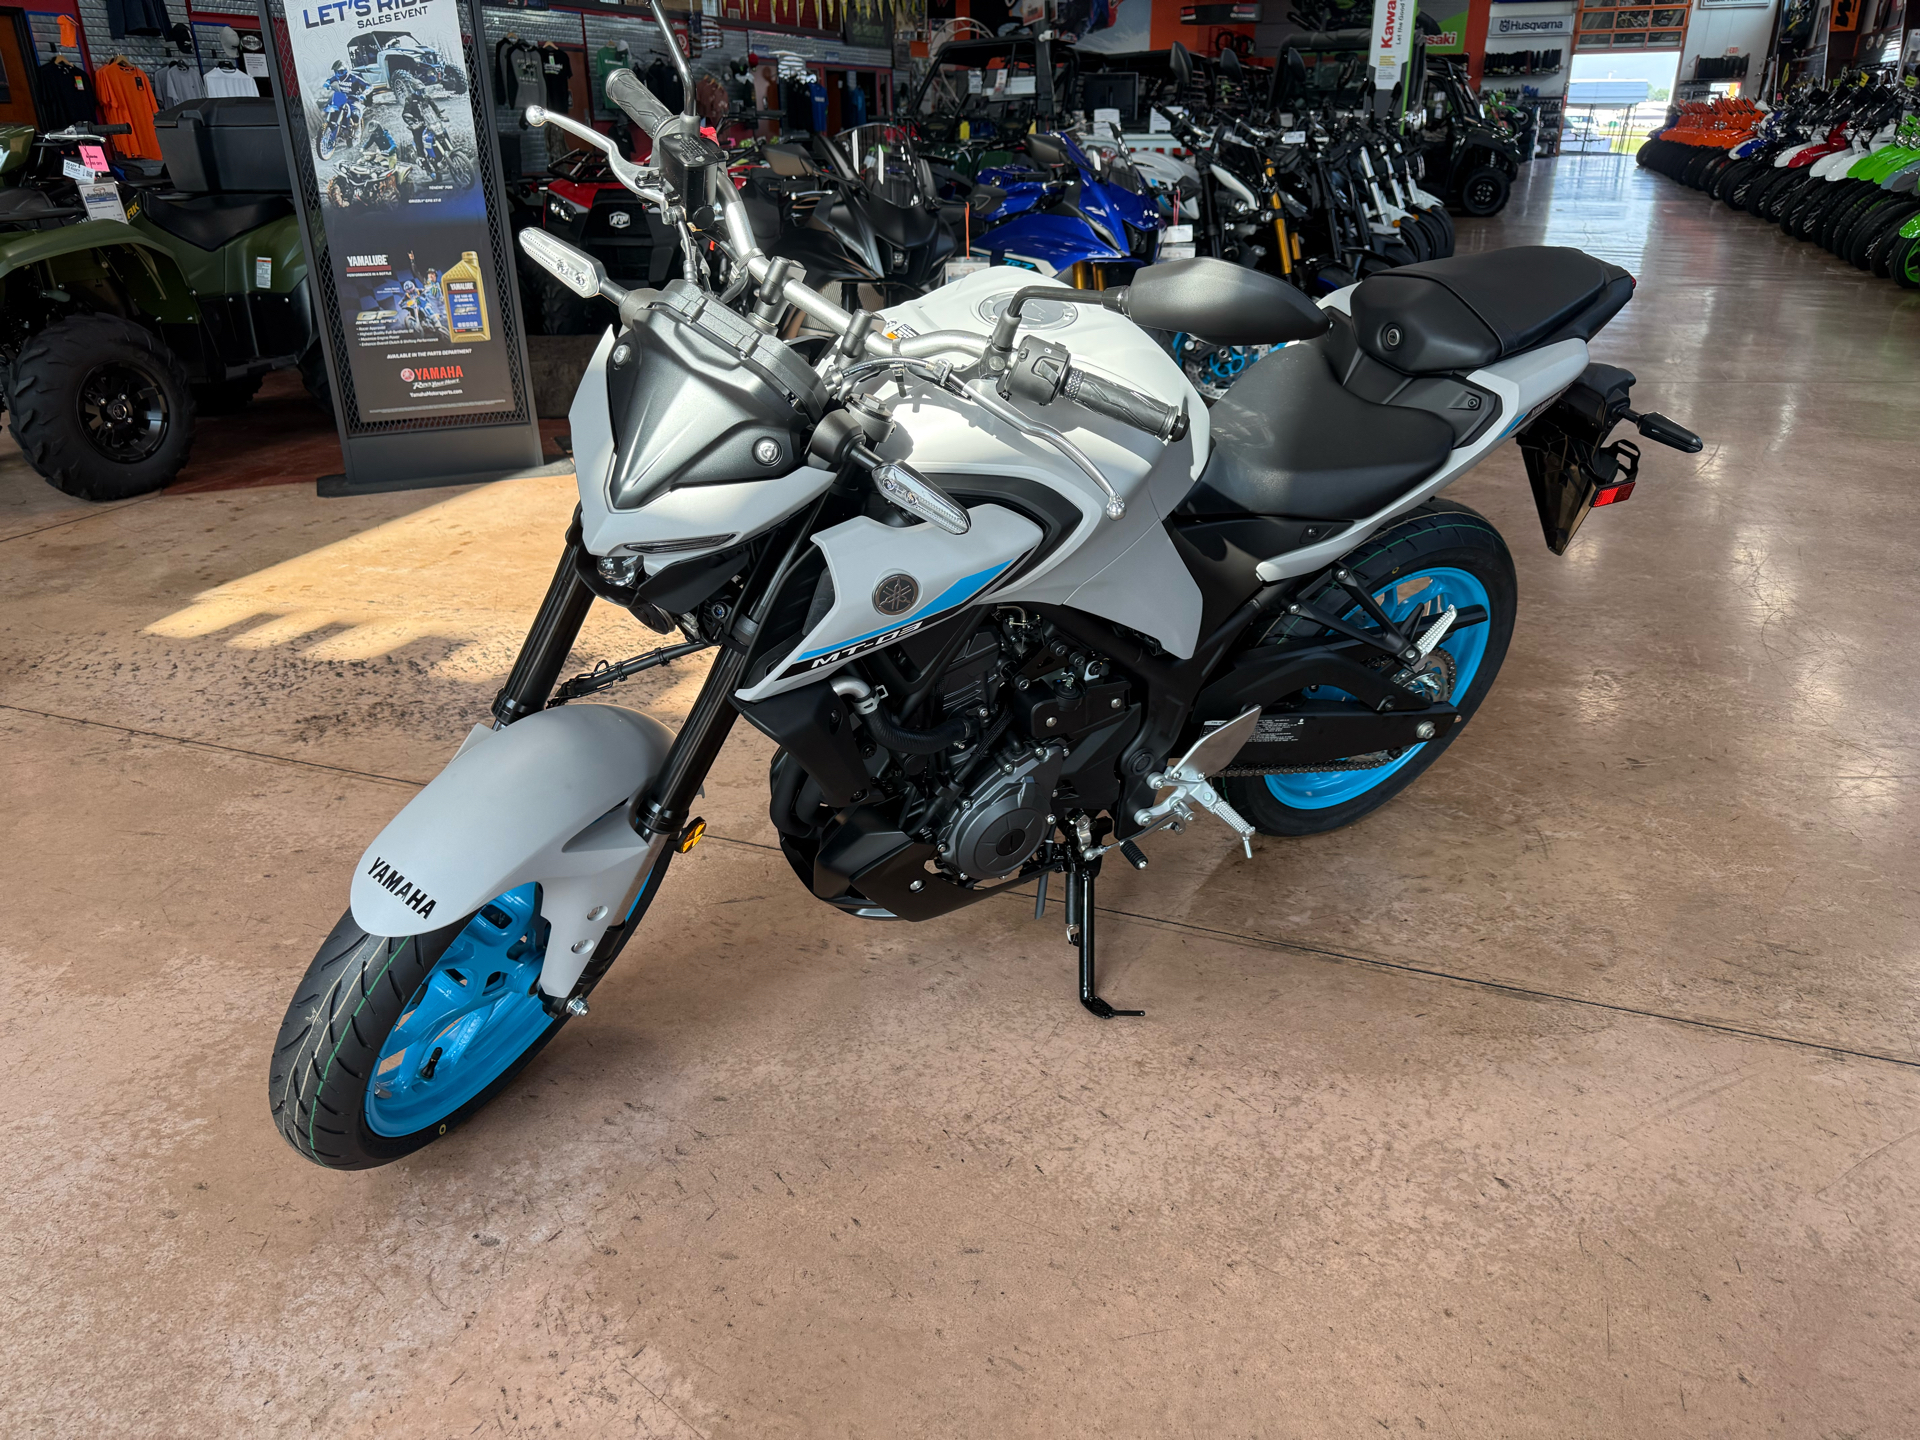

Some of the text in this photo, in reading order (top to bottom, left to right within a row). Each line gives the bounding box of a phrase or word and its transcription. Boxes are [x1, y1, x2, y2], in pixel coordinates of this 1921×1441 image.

[303, 0, 372, 29] LET'S
[357, 6, 428, 29] SALES EVENT
[1510, 19, 1563, 31] Husqvarna
[1424, 32, 1456, 45] saki
[347, 255, 388, 267] YAMALUBE
[414, 365, 464, 380] YAMAHA
[409, 389, 463, 398] YamahaMotorsports.com
[811, 621, 923, 669] MT-03
[367, 856, 437, 920] YAMAHA
